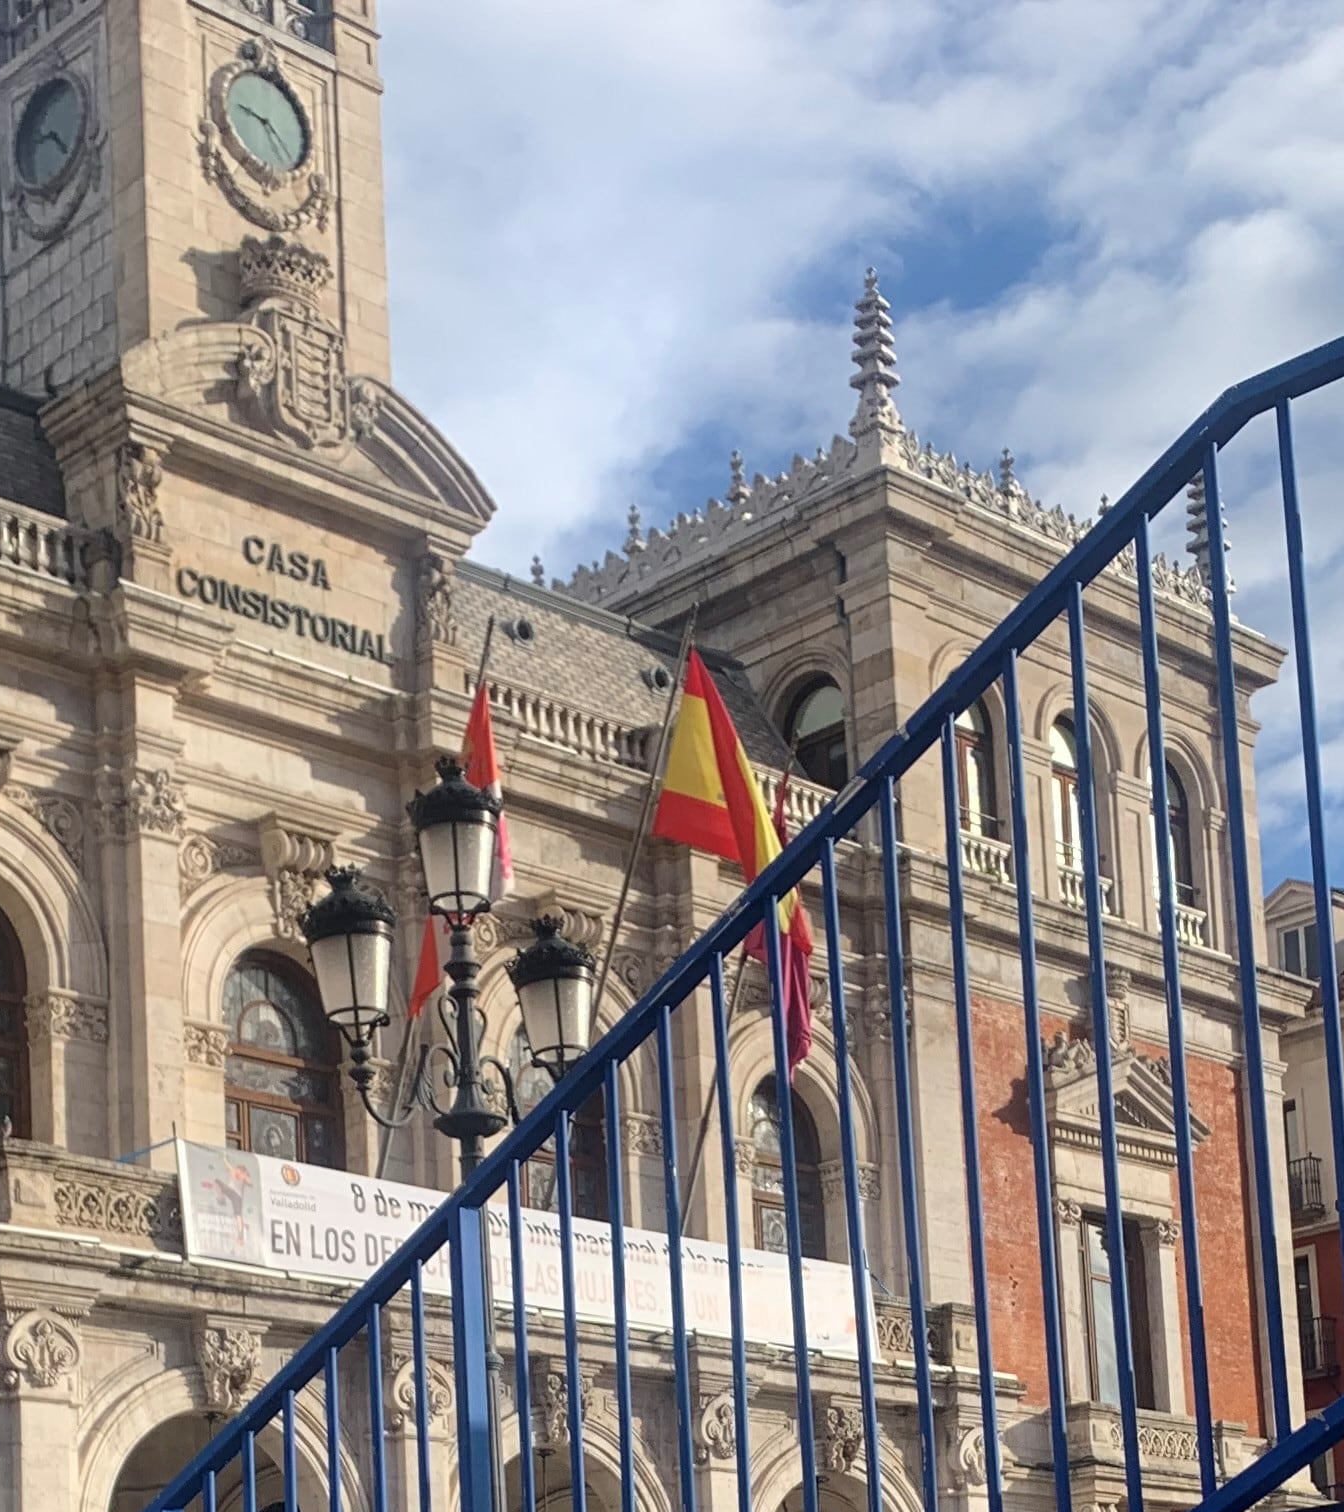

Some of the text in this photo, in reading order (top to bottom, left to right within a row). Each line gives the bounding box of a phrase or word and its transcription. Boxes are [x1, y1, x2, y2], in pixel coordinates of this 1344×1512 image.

[242, 536, 331, 590] CASA
[176, 567, 400, 667] CONSISTORIAL
[270, 1197, 317, 1212] Valladolid
[351, 1183, 366, 1213] 8
[373, 1187, 401, 1219] de
[270, 1218, 301, 1257] EN
[310, 1224, 356, 1264] LOS
